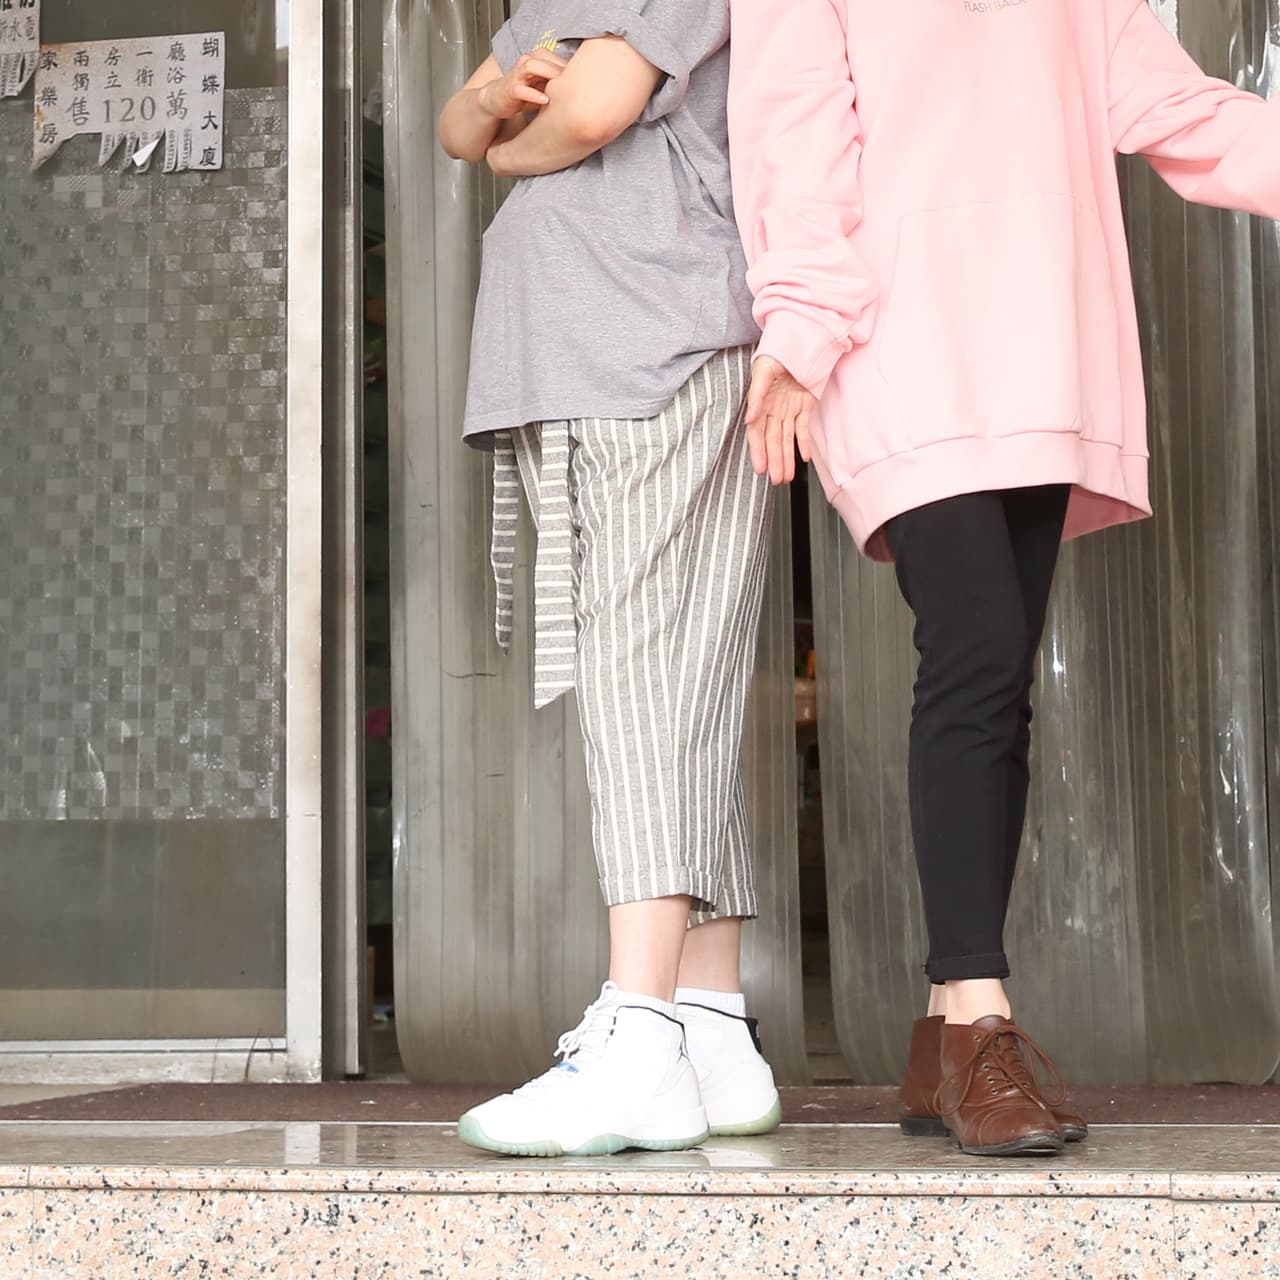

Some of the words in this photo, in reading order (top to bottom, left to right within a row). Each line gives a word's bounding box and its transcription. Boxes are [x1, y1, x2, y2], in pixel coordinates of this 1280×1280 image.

[73, 40, 186, 67] 兩房一廳
[39, 50, 59, 146] 家樂房
[71, 66, 188, 93] 獨立衛浴
[65, 88, 189, 127] 售120萬
[199, 36, 221, 167] 蝴蝶大廈
